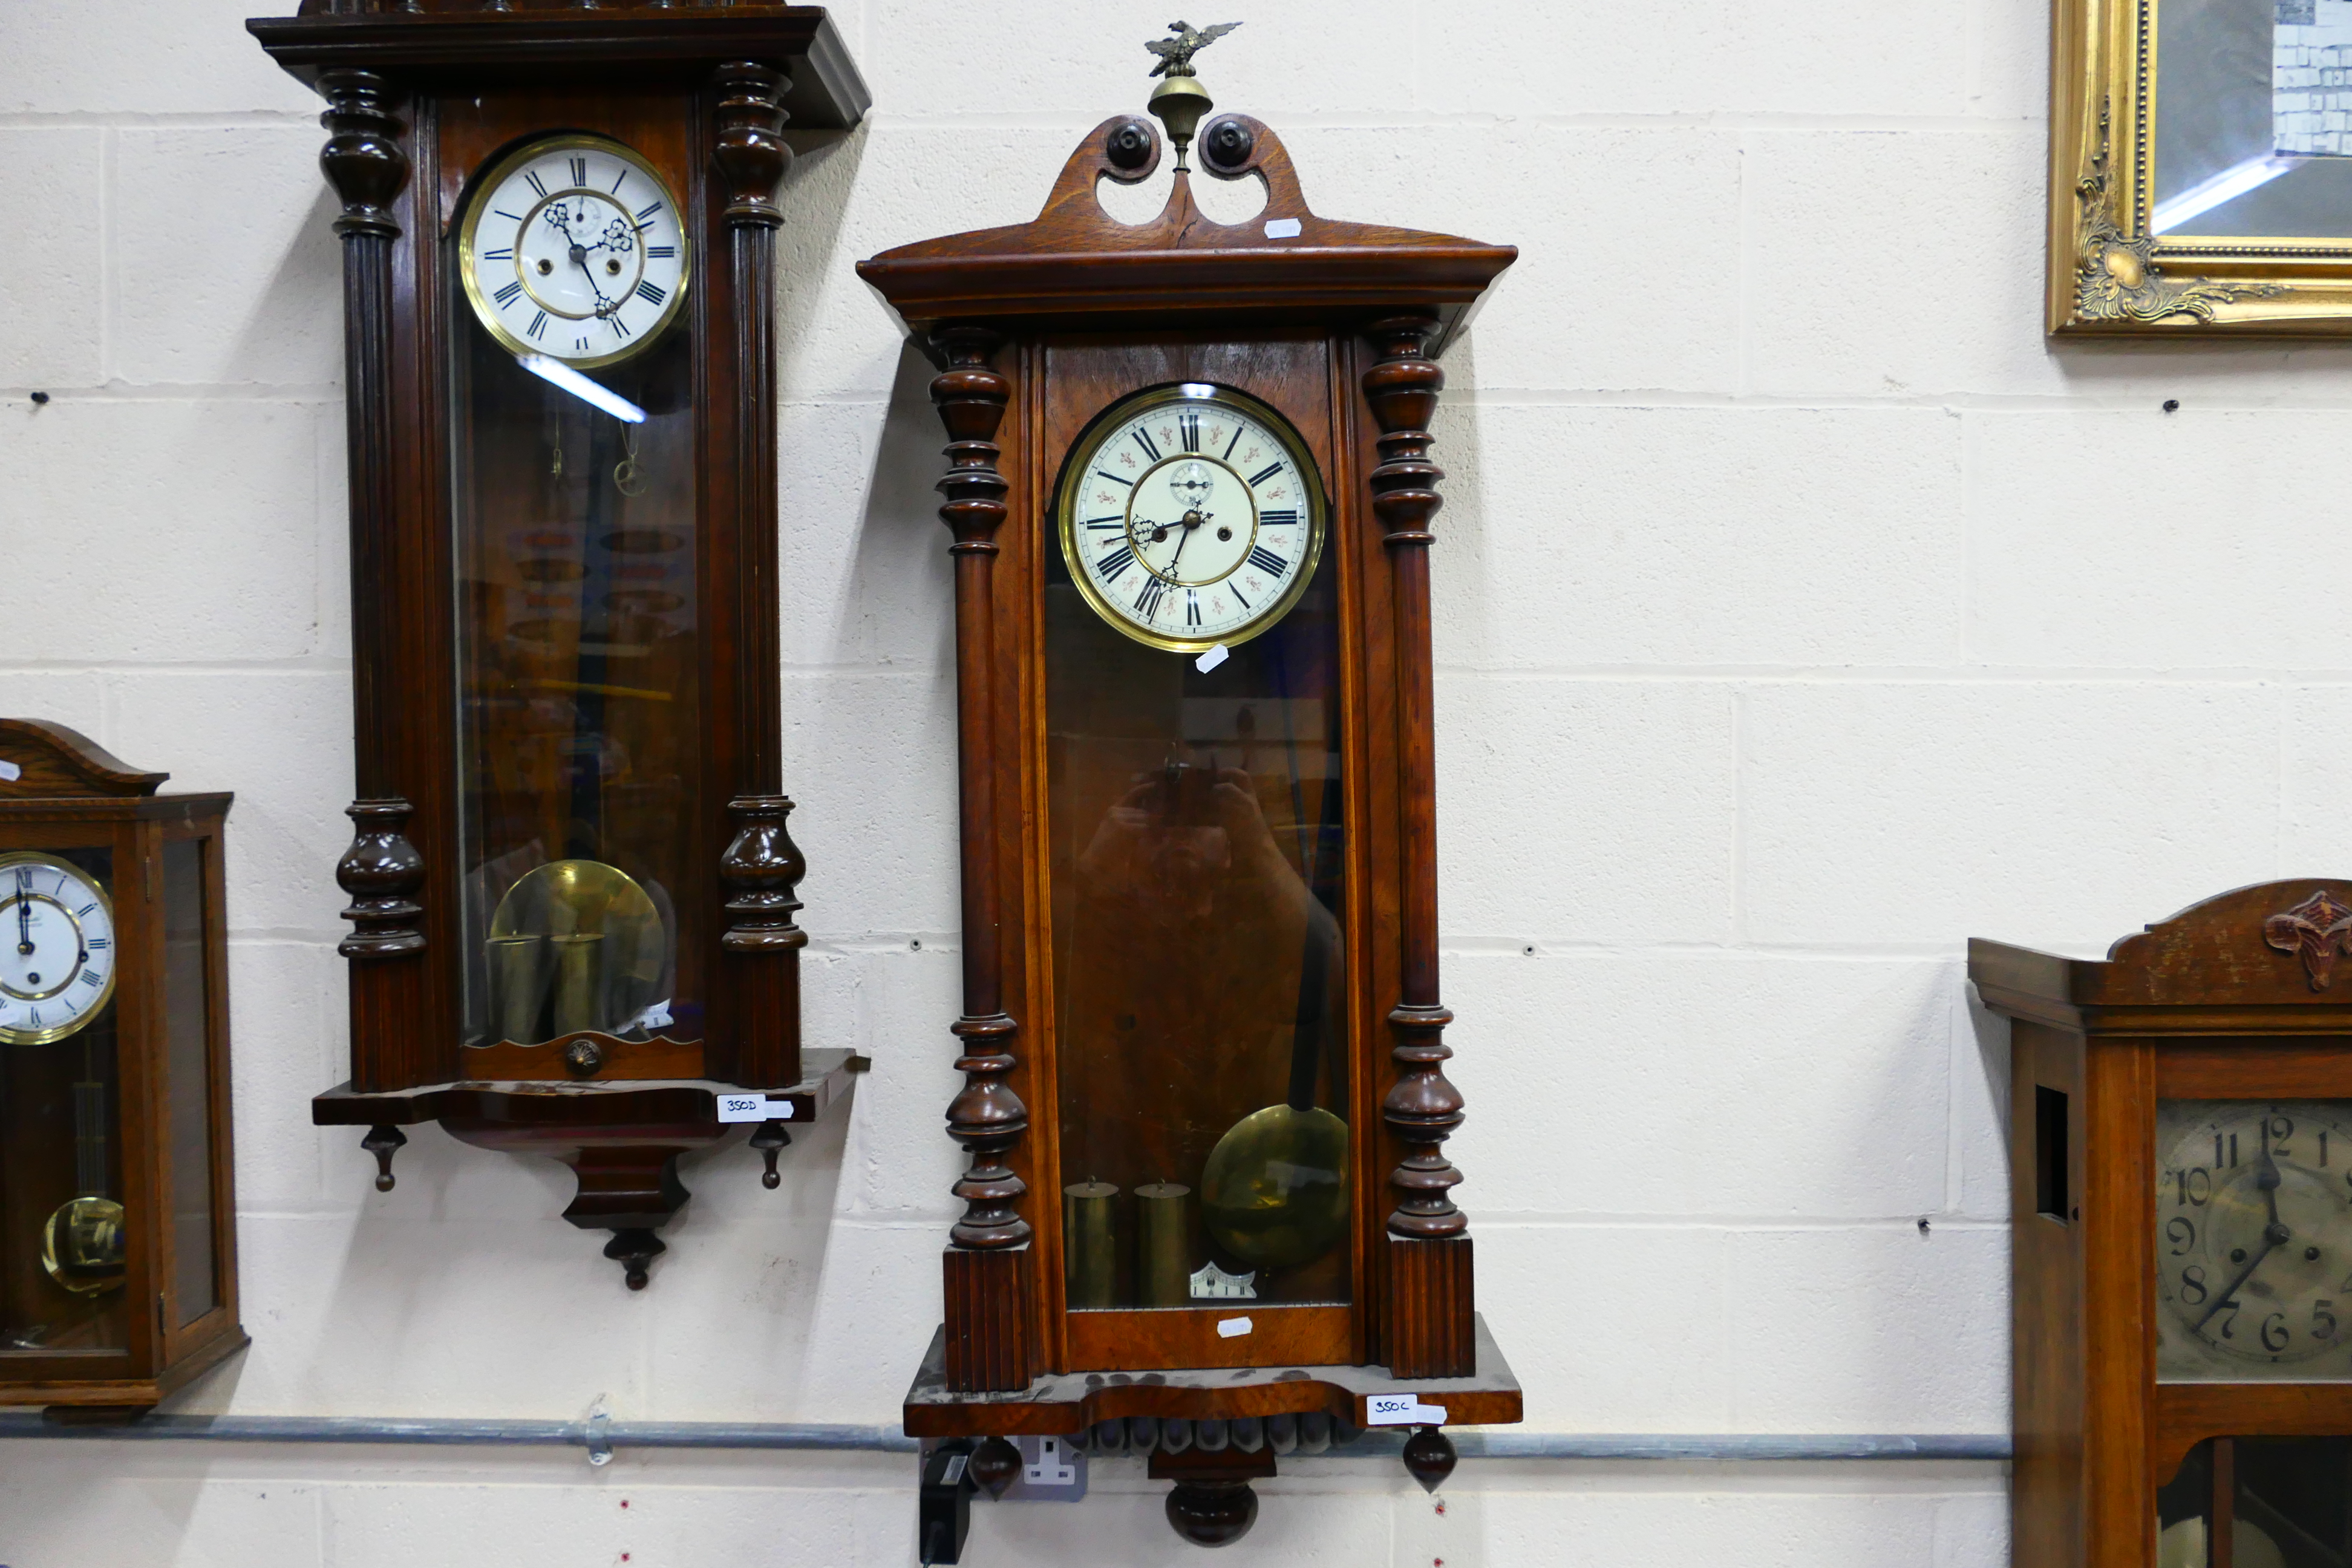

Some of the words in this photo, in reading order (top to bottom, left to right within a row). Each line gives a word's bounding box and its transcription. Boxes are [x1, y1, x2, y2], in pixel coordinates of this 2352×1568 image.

[612, 169, 627, 195] I
[636, 201, 663, 221] II
[647, 246, 675, 258] III
[494, 281, 523, 311] VIII
[636, 279, 667, 306] IIII
[527, 310, 549, 341] VII
[1131, 426, 1162, 462] XI
[1178, 414, 1200, 452] XII
[1223, 426, 1244, 460] I
[1247, 461, 1284, 488] II
[1086, 515, 1124, 530] IX
[1259, 510, 1298, 526] III
[1096, 545, 1136, 584] VIII
[1247, 545, 1289, 579] IIII
[1186, 589, 1203, 626] VI
[1227, 579, 1251, 612] V
[54, 878, 65, 895] I
[77, 904, 95, 917] II
[88, 939, 106, 950] III
[727, 1100, 757, 1111] 350D
[2214, 1132, 2238, 1169] 11
[2261, 1117, 2295, 1156] 12
[2318, 1131, 2328, 1168] 1
[2178, 1167, 2211, 1206] 10
[2166, 1217, 2197, 1256] 9
[2181, 1265, 2208, 1305] 8
[2260, 1313, 2290, 1352] 6
[2311, 1299, 2337, 1340] 5
